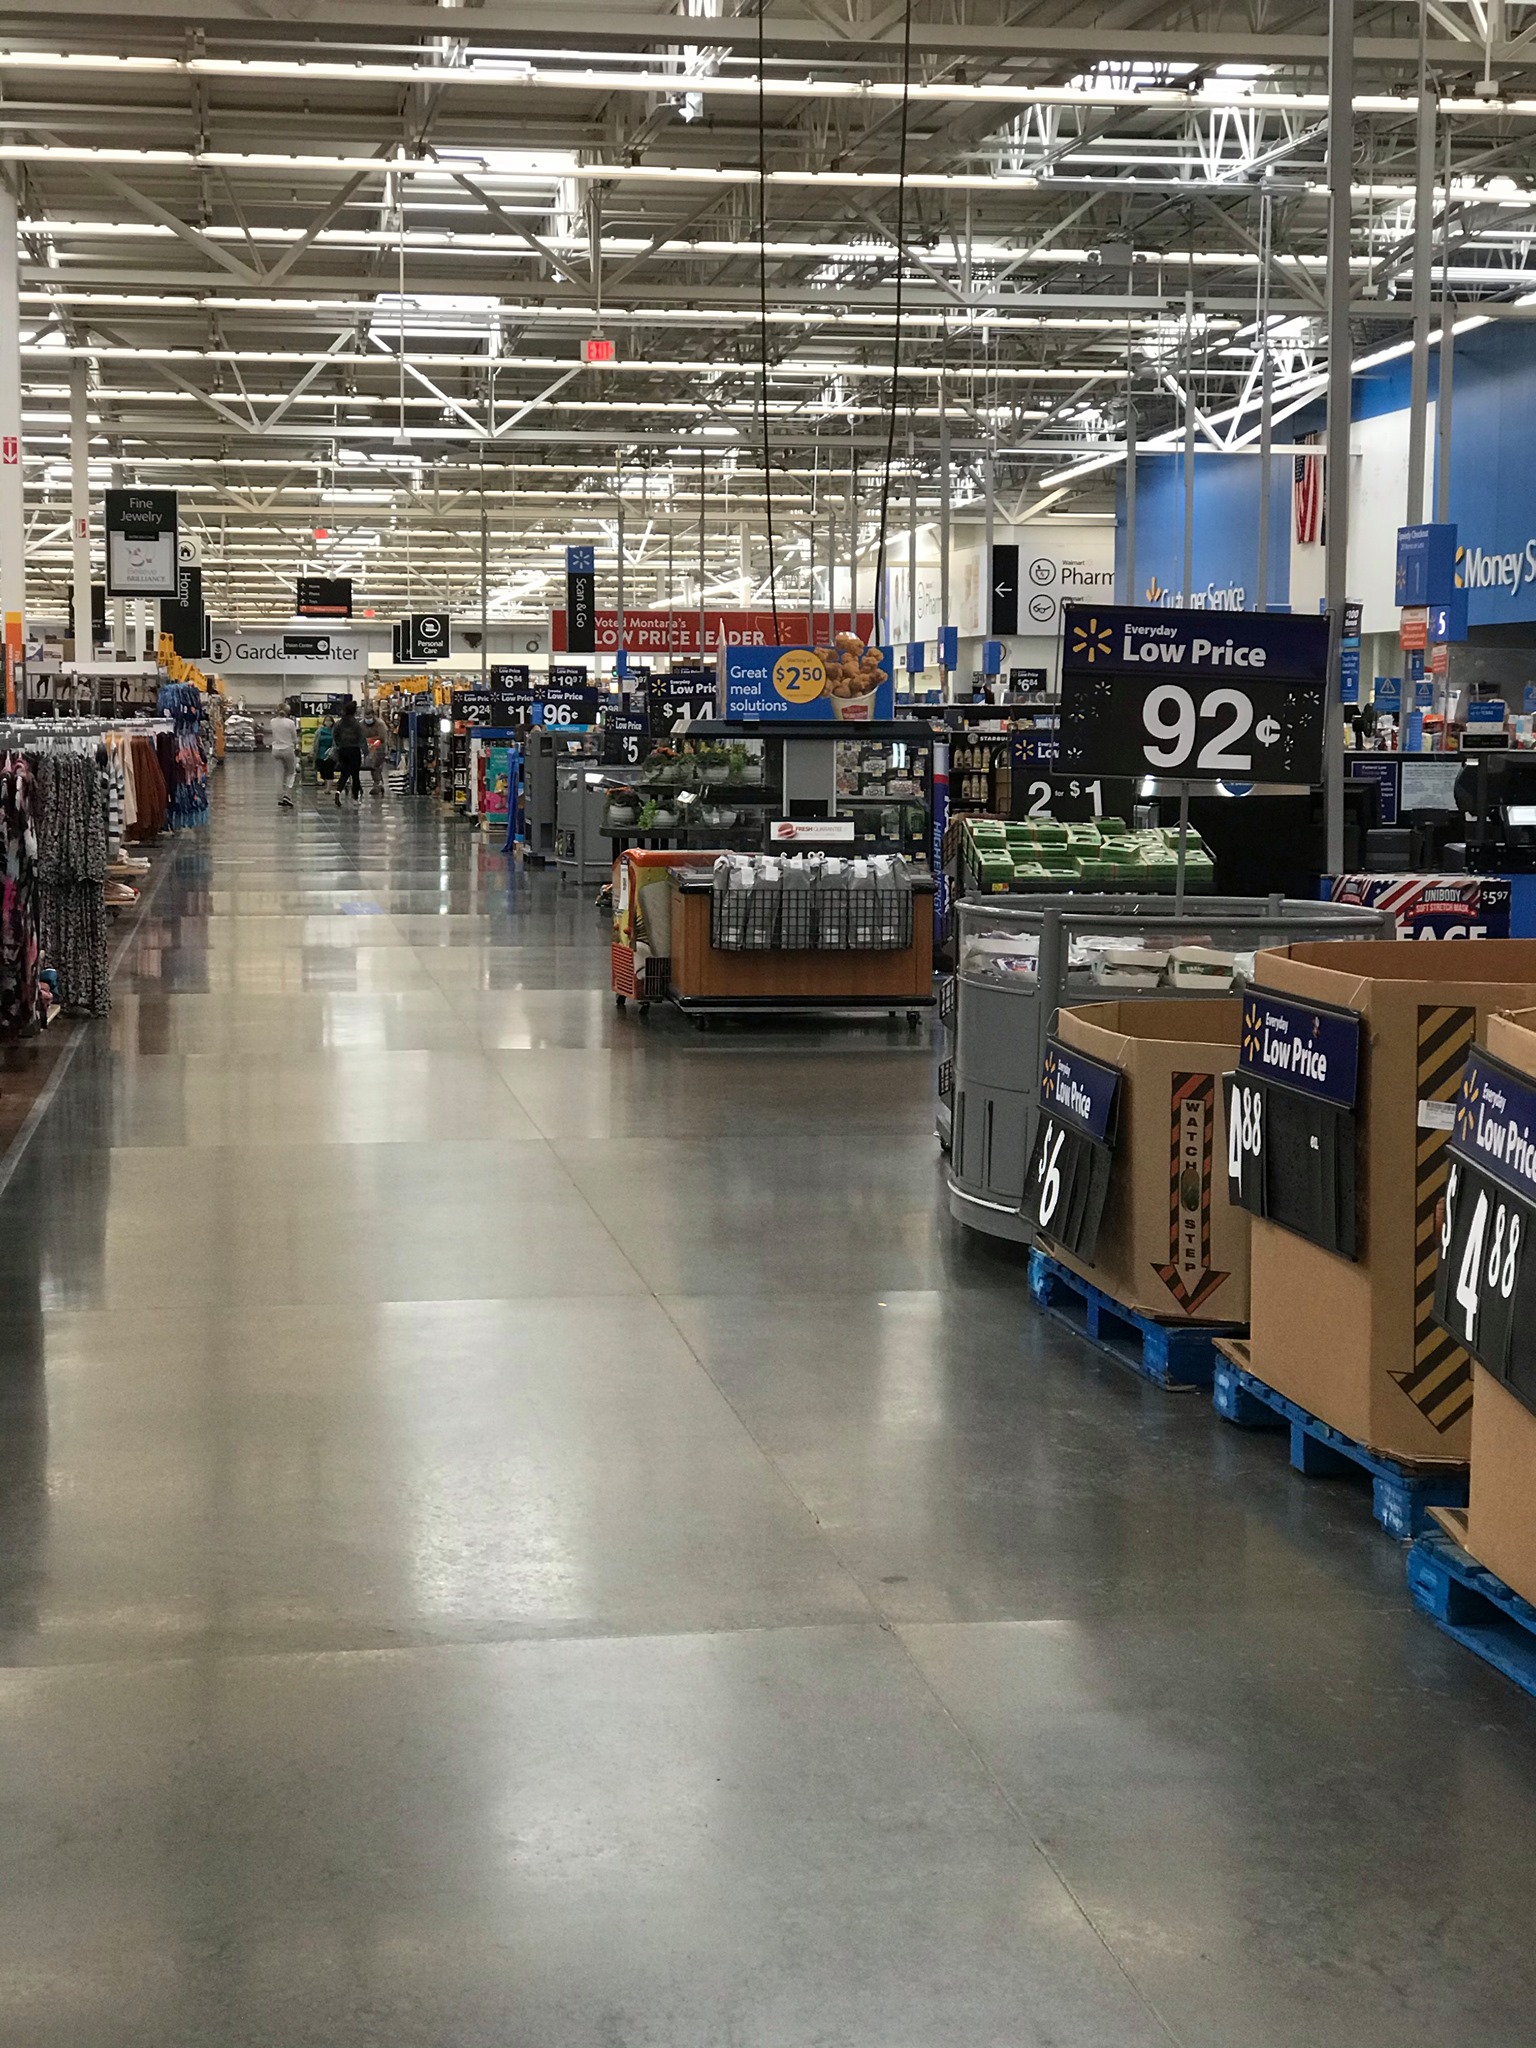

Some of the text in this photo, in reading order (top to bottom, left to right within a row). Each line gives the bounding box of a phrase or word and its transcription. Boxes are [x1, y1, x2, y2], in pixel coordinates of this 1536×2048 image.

[588, 341, 610, 360] EXIT
[129, 497, 153, 509] Fine
[120, 510, 163, 524] Jewelry
[1062, 567, 1115, 585] Pharm
[1414, 561, 1420, 594] 1
[1464, 538, 1536, 596] Money S
[126, 575, 165, 583] BRILLIANCE
[180, 572, 191, 607] Home
[576, 578, 587, 628] Scan & Go
[1208, 580, 1245, 611] Service
[1124, 623, 1178, 639] Everyday
[1438, 611, 1446, 635] 5
[639, 630, 690, 646] PRICE
[236, 643, 297, 660] Garde
[1122, 635, 1267, 667] Low Price
[730, 665, 768, 679] Great
[547, 692, 564, 700] Low
[670, 682, 716, 695] Low Pric
[730, 682, 761, 695] meal
[543, 704, 578, 726] 96¢
[730, 699, 788, 712] solutions
[615, 721, 642, 731] Low Price
[622, 736, 639, 763] $5
[1028, 779, 1103, 817] 2 for $1
[933, 820, 942, 858] HIGH
[1416, 902, 1469, 912] SOFT STRETCH MASK
[1424, 888, 1461, 903] UNIBODY
[1265, 1011, 1289, 1035] Everyday
[1263, 1028, 1327, 1082] Low Price
[1058, 1059, 1071, 1078] Everyday
[1055, 1072, 1092, 1120] Low Price
[1482, 1082, 1507, 1114] Everyday
[1185, 1102, 1201, 1170] WATCH
[1476, 1102, 1505, 1159] Low
[1038, 1119, 1066, 1228] $6
[1184, 1218, 1196, 1272] STEP
